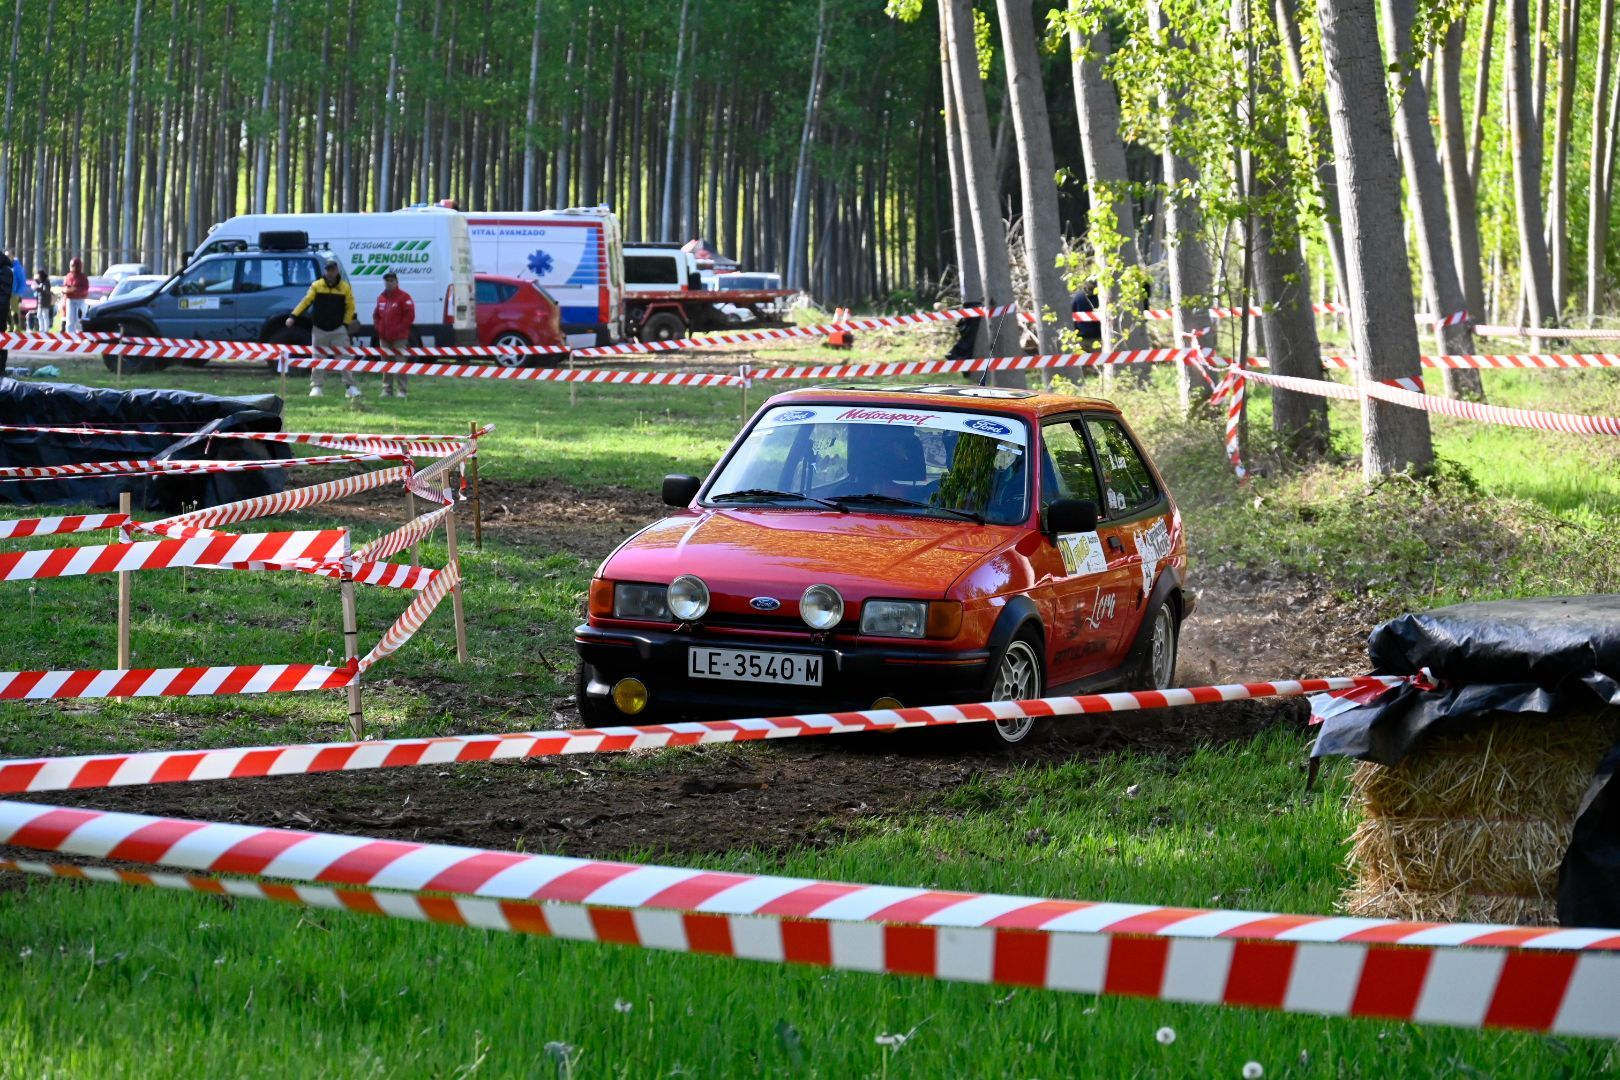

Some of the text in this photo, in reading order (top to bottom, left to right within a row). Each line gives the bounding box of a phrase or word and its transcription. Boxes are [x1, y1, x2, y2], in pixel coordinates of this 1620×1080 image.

[349, 241, 393, 250] DESGUACE
[351, 253, 430, 264] EL PENOSILLO
[836, 408, 940, 426] Motorsport
[971, 418, 1005, 434] Ford
